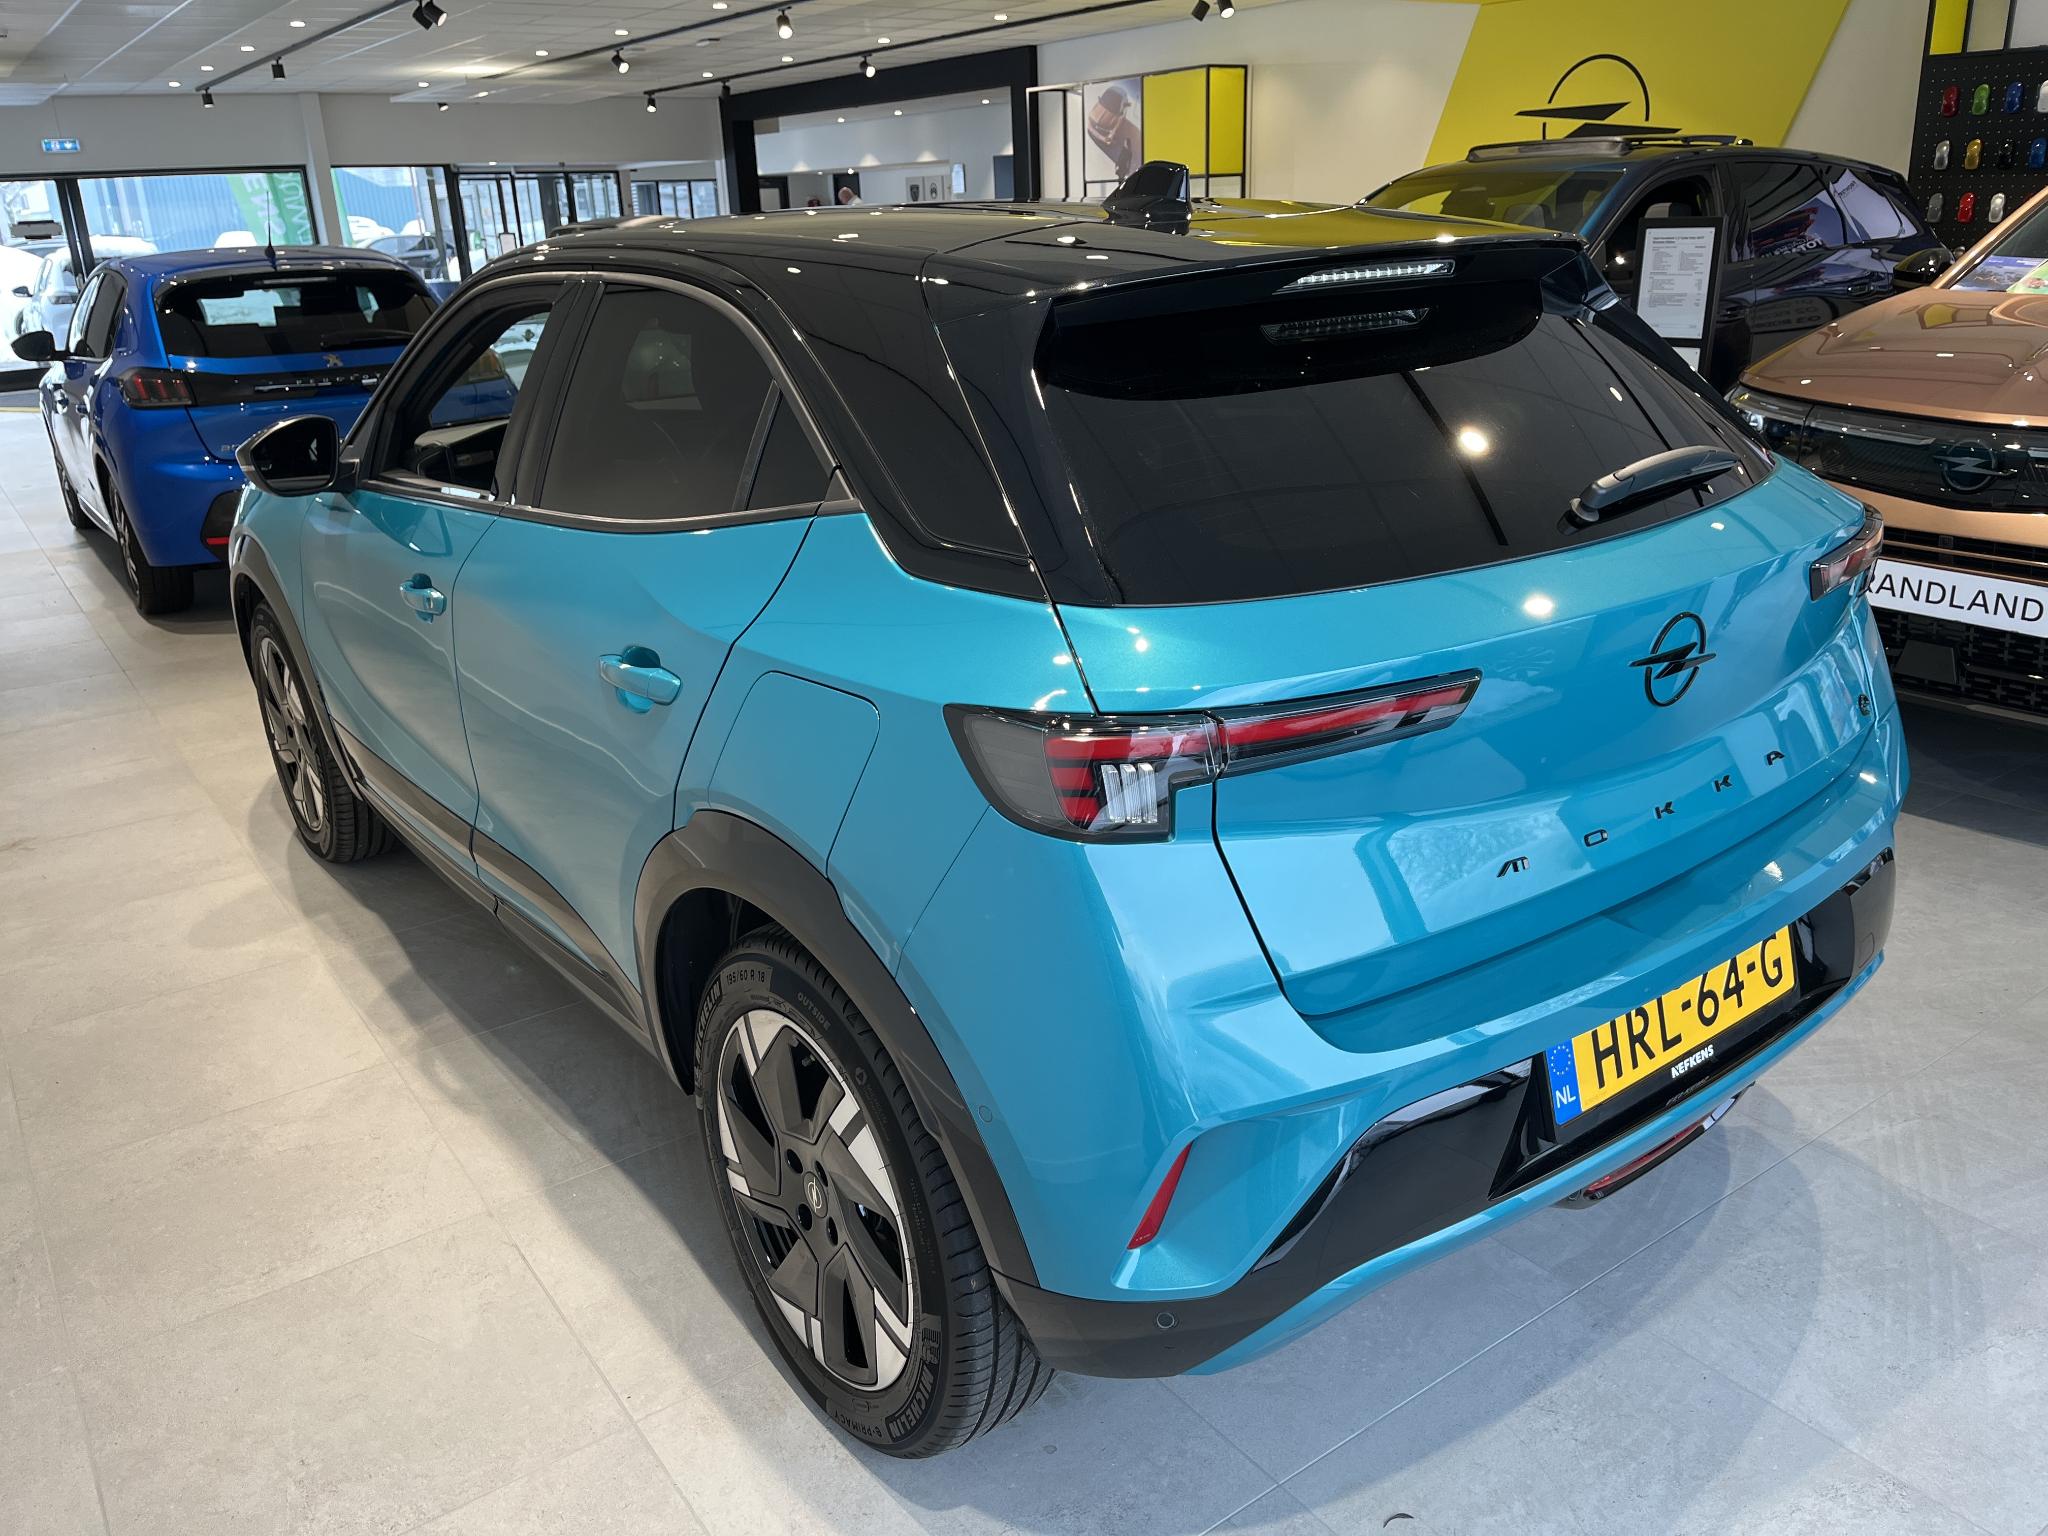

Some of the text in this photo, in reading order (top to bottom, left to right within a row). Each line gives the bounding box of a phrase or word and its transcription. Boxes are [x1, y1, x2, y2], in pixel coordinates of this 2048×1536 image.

[1497, 751, 1785, 878] MOKKA
[726, 969, 748, 985] 195/60
[758, 970, 766, 983] 18
[797, 992, 832, 1031] OUTSIDE
[1591, 933, 1784, 1089] HRL-64-G
[1671, 1044, 1714, 1079] NEFKENS
[1555, 1085, 1576, 1108] NL
[888, 1364, 935, 1438] MICHELIN
